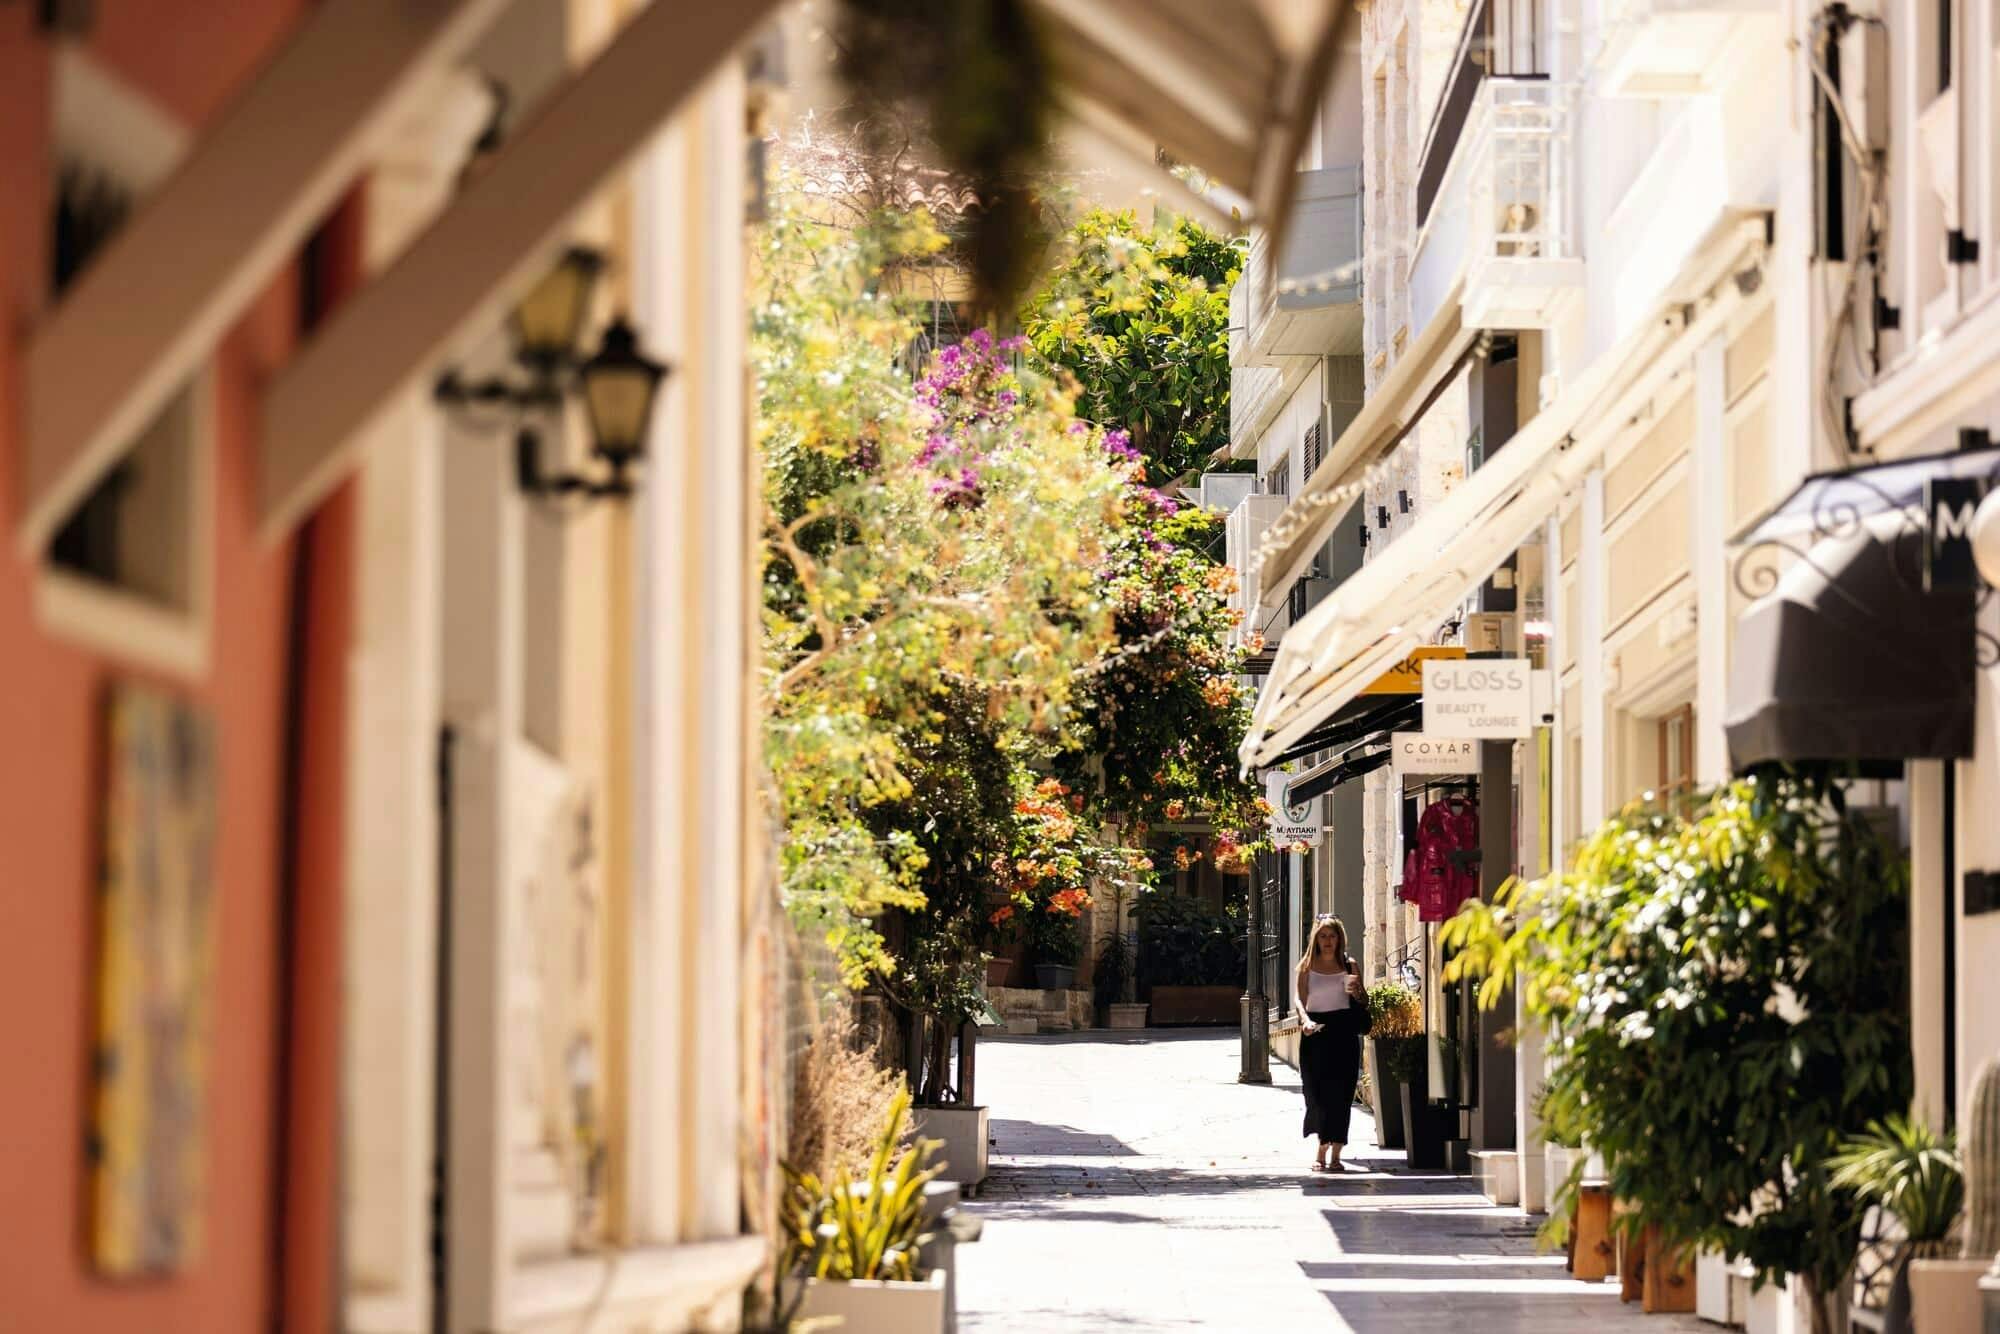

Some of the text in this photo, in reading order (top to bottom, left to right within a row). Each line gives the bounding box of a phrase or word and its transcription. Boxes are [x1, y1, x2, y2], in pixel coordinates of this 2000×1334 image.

[1431, 669, 1523, 691] GLOSS
[1436, 703, 1486, 714] BEAUTY
[1468, 716, 1518, 728] LOUNGE
[1404, 742, 1472, 754] COYAR
